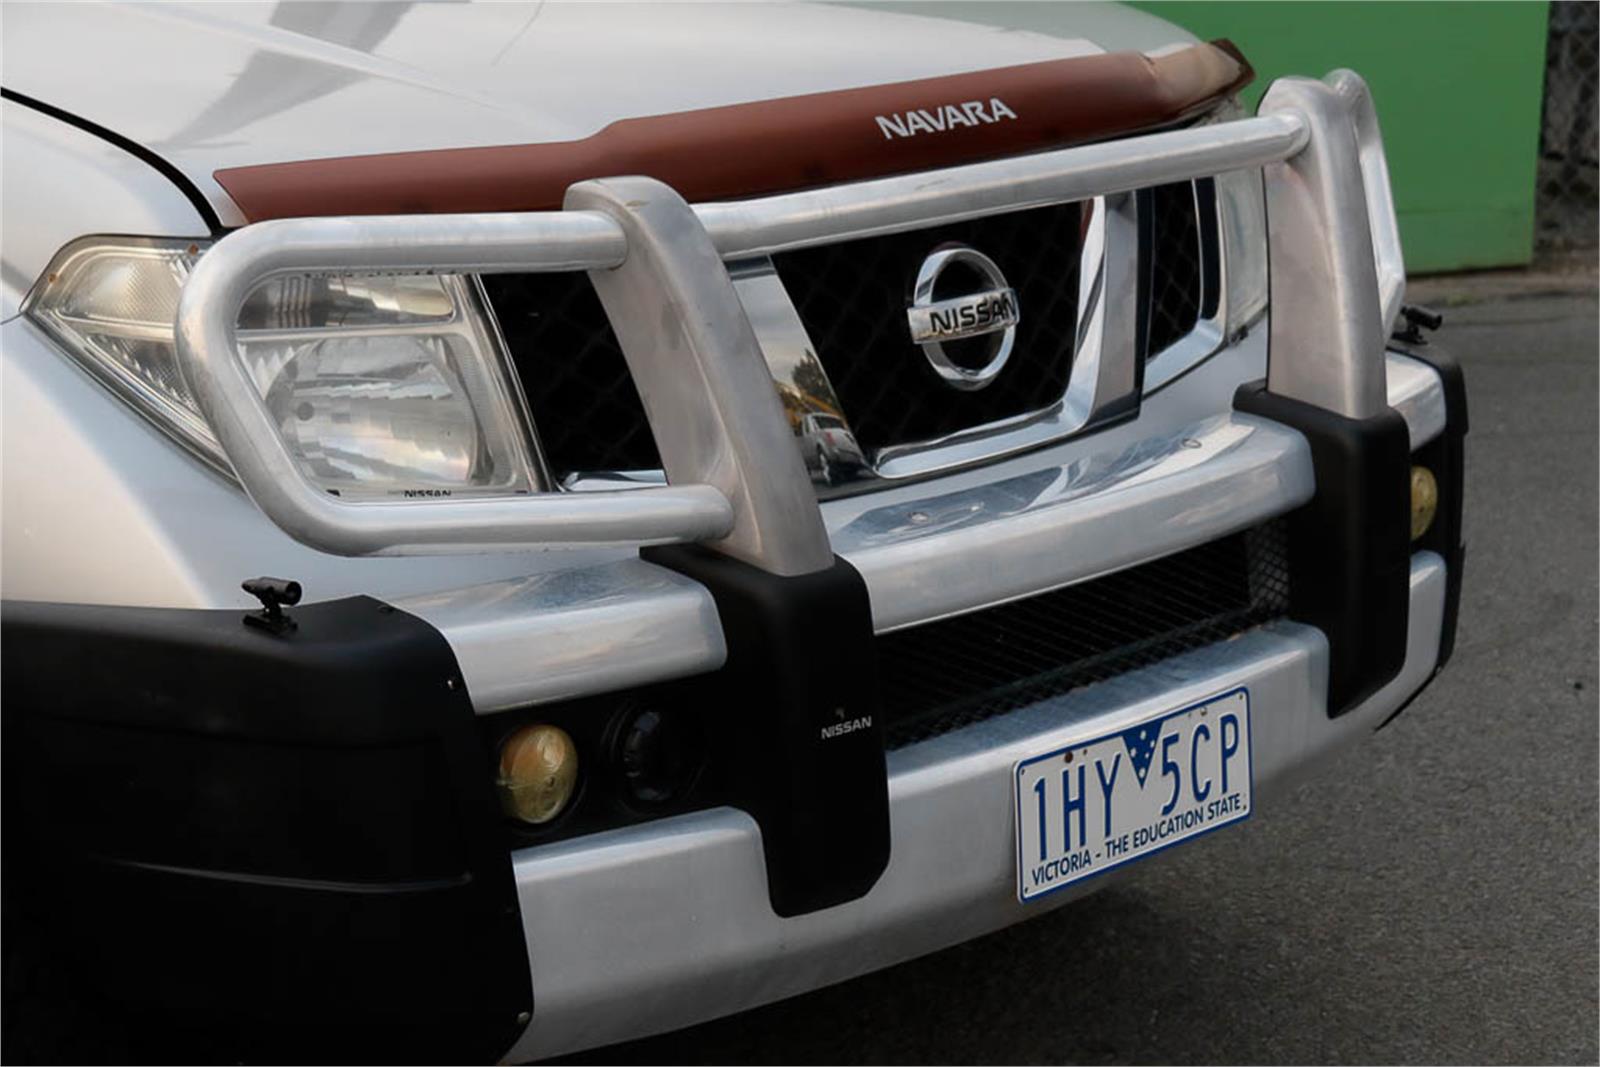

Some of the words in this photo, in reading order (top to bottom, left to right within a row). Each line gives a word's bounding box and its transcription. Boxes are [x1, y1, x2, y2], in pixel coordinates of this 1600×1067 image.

[875, 98, 1017, 139] NAVARA
[929, 291, 1017, 332] NISSAN
[821, 715, 872, 740] NISSAN
[1034, 754, 1121, 861] 1HY
[1162, 714, 1239, 816] 5CP
[1031, 849, 1092, 886] VICTORIA
[1105, 834, 1129, 858] THE
[1133, 808, 1204, 849] EDUCATION
[1208, 793, 1240, 820] STATE
